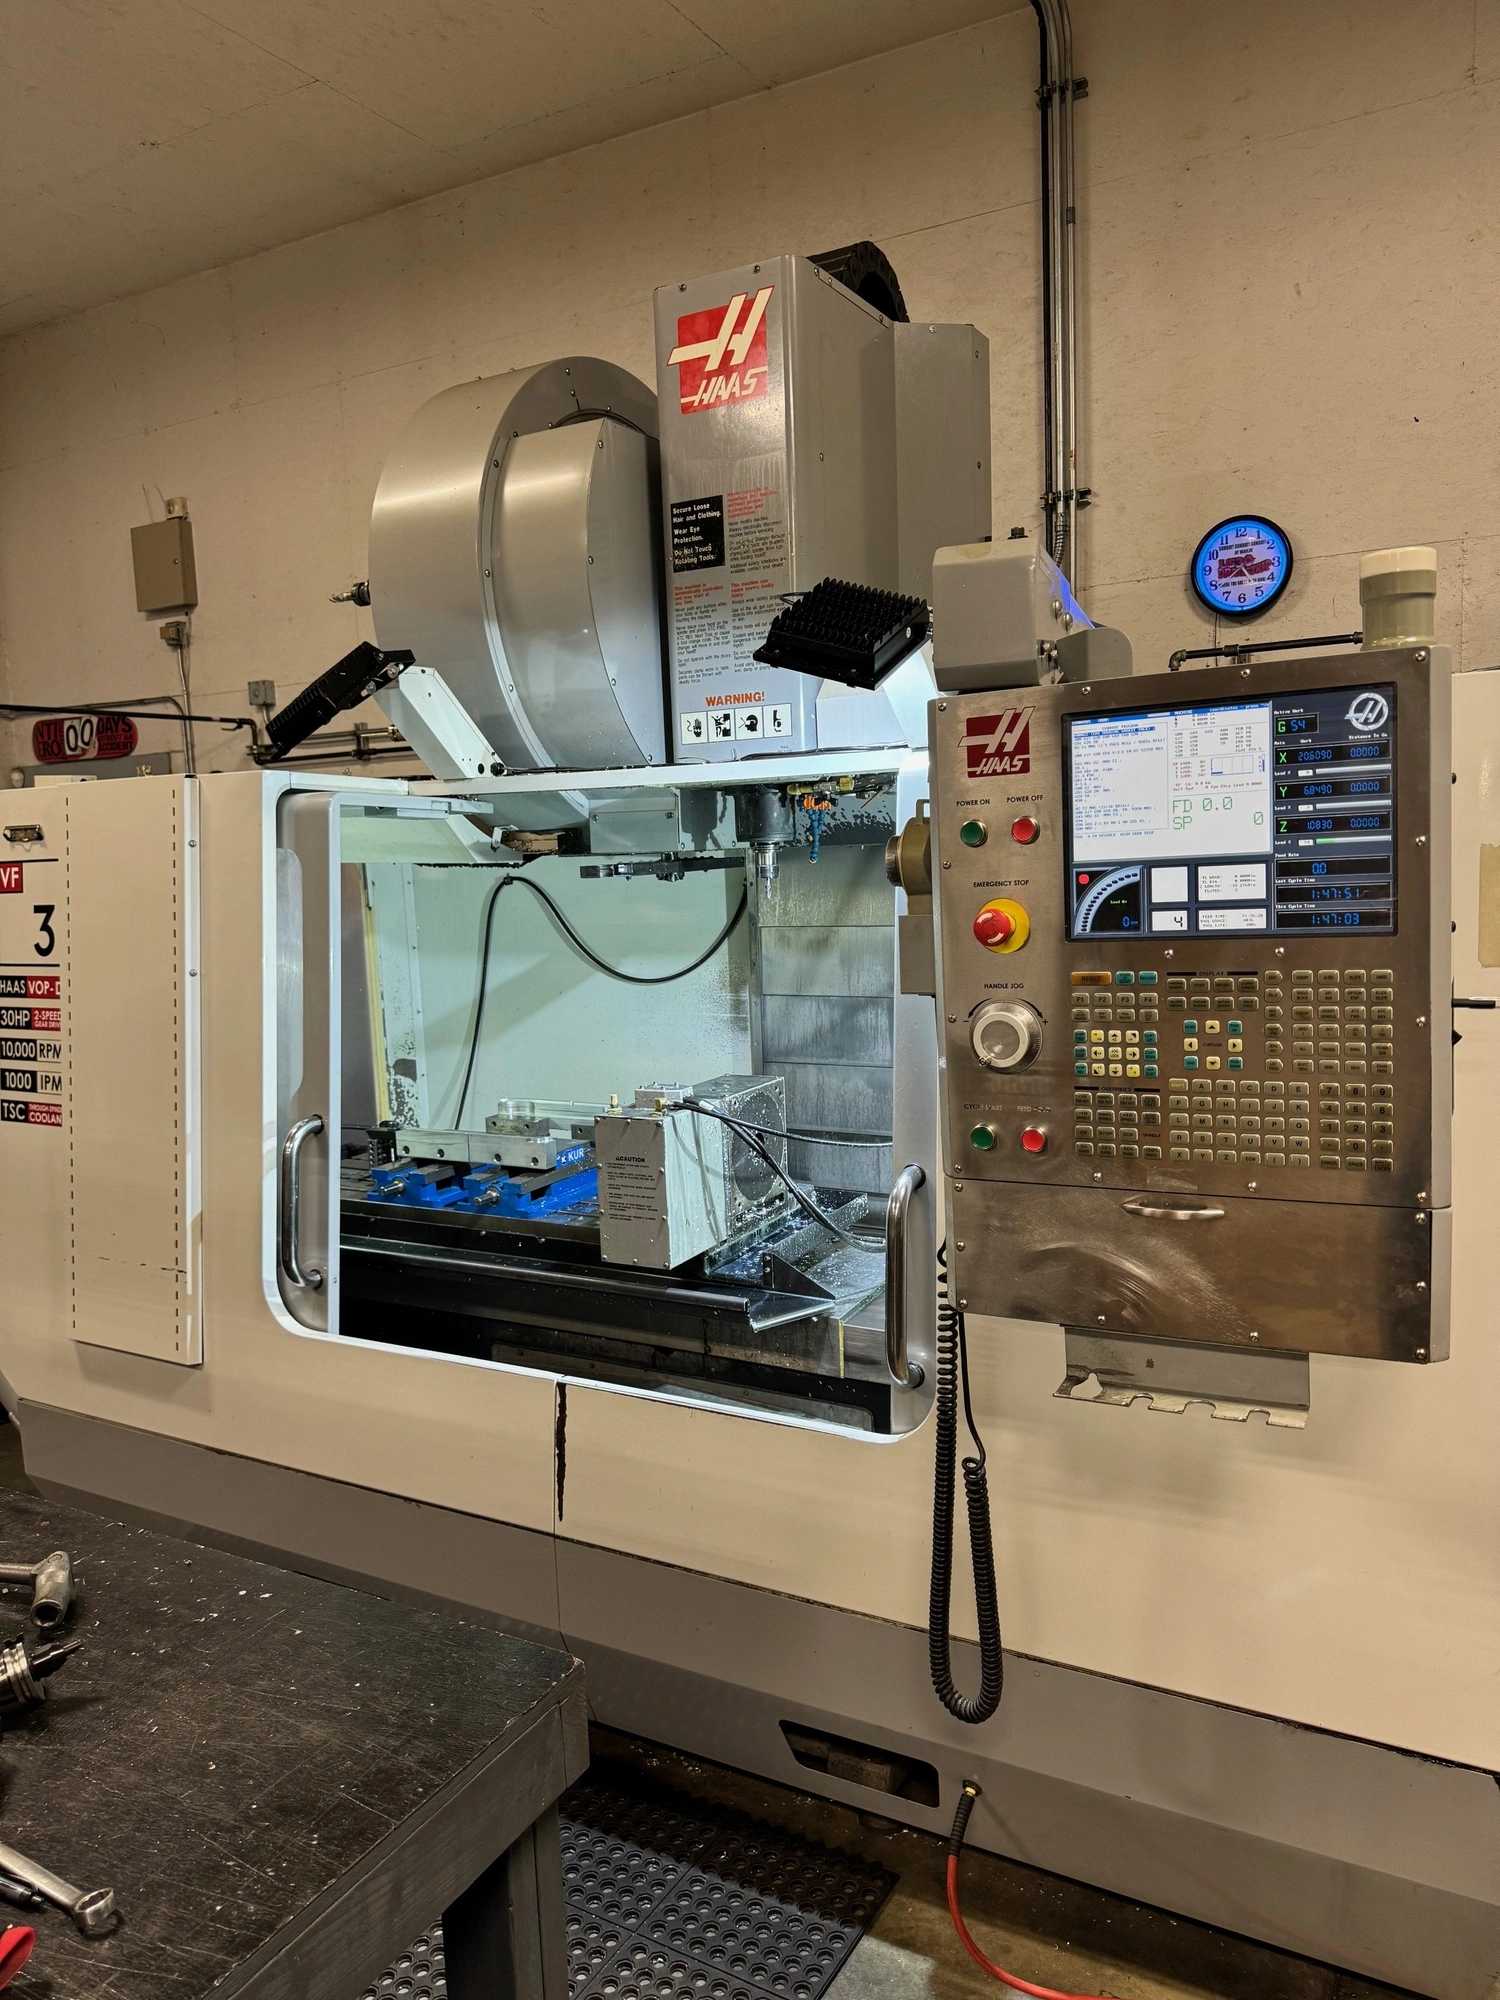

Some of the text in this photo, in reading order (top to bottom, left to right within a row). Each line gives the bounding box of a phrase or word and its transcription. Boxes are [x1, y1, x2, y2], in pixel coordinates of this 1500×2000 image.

[680, 366, 768, 407] HAAS
[1235, 527, 1247, 538] 12
[1256, 529, 1261, 539] 1
[1220, 535, 1229, 545] 11
[1267, 539, 1275, 550] 2
[695, 543, 712, 552] Touch
[1208, 549, 1219, 561] 10
[1272, 556, 1281, 567] 3
[1203, 565, 1212, 576] 9
[1267, 572, 1275, 582] 4
[1209, 580, 1218, 591] 8
[1255, 586, 1264, 597] 5
[1222, 591, 1231, 601] 7
[1238, 593, 1247, 603] 6
[705, 691, 765, 706] WARNING!
[98, 716, 133, 736] DAYS
[1278, 721, 1286, 732] G
[1280, 752, 1287, 764] X
[967, 754, 1030, 775] HAAS
[1280, 786, 1288, 798] Y
[1173, 797, 1233, 813] FD 0.0
[1173, 816, 1192, 830] SP
[1254, 812, 1264, 825] 0
[1280, 821, 1288, 832] Z
[0, 867, 20, 888] VF
[1312, 887, 1360, 899] 1:47:51
[1174, 916, 1183, 928] 4
[1312, 913, 1360, 925] 1:47:03
[34, 905, 55, 957] 3
[0, 980, 26, 993] HAAS
[0, 1009, 30, 1027] 30HP
[2, 1040, 35, 1058] 10,000
[5, 1072, 62, 1091] 1000 IPM
[2, 1102, 26, 1120] TSC
